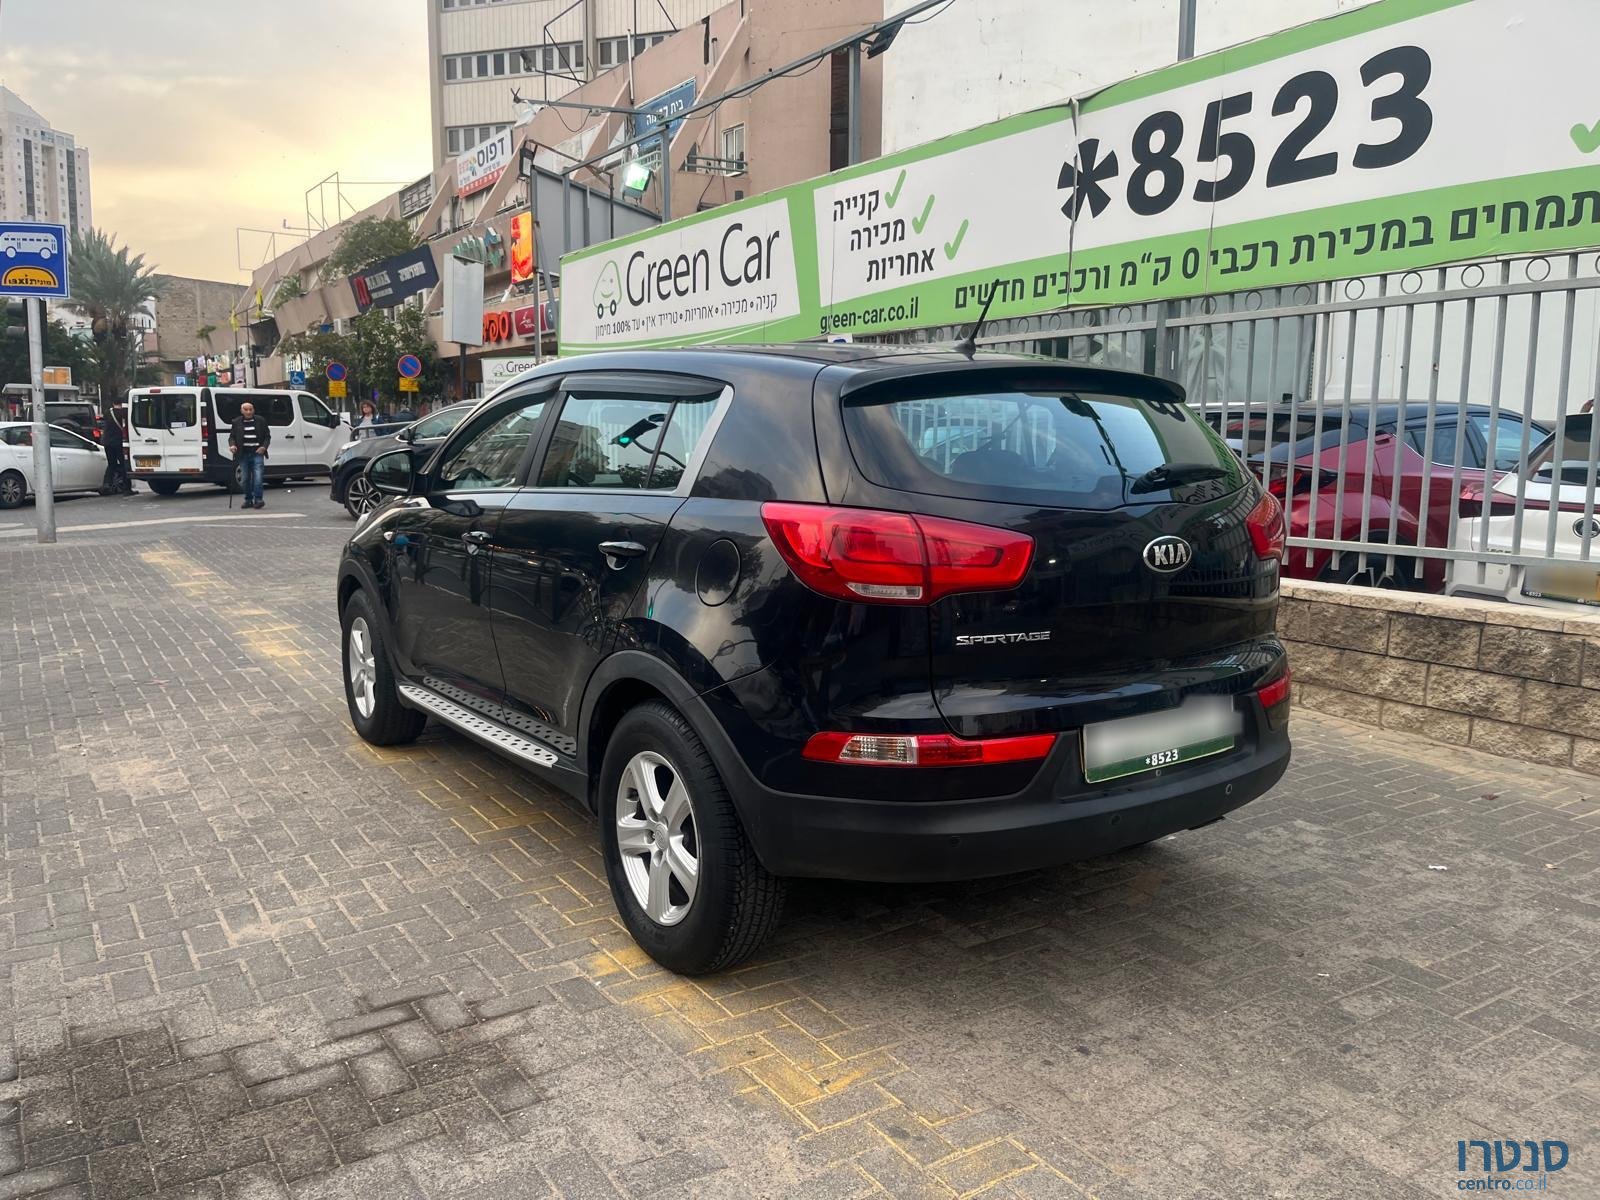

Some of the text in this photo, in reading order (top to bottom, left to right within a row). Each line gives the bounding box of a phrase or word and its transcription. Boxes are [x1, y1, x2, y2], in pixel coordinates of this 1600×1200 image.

[476, 136, 505, 168] דפוס
[833, 190, 880, 222] קנייה
[1450, 190, 1600, 242] תמחים
[850, 218, 906, 251] מכירה
[1289, 215, 1434, 265] במכירת
[626, 222, 780, 307] Green Car
[866, 248, 935, 282] אחריות
[1182, 247, 1200, 280] 0
[1210, 240, 1279, 275] רכבי
[955, 278, 1025, 309] חדשים
[1033, 265, 1110, 298] ורכבים
[685, 307, 714, 323] אחריות
[720, 299, 748, 316] מכירה
[756, 293, 777, 314] קניה
[820, 296, 919, 334] green-car.co.il
[595, 323, 611, 340] מימון
[612, 320, 631, 334] 100%
[632, 318, 641, 330] עד
[645, 315, 656, 332] אין
[1152, 543, 1187, 566] KIA
[956, 631, 1051, 646] SPORTAGE
